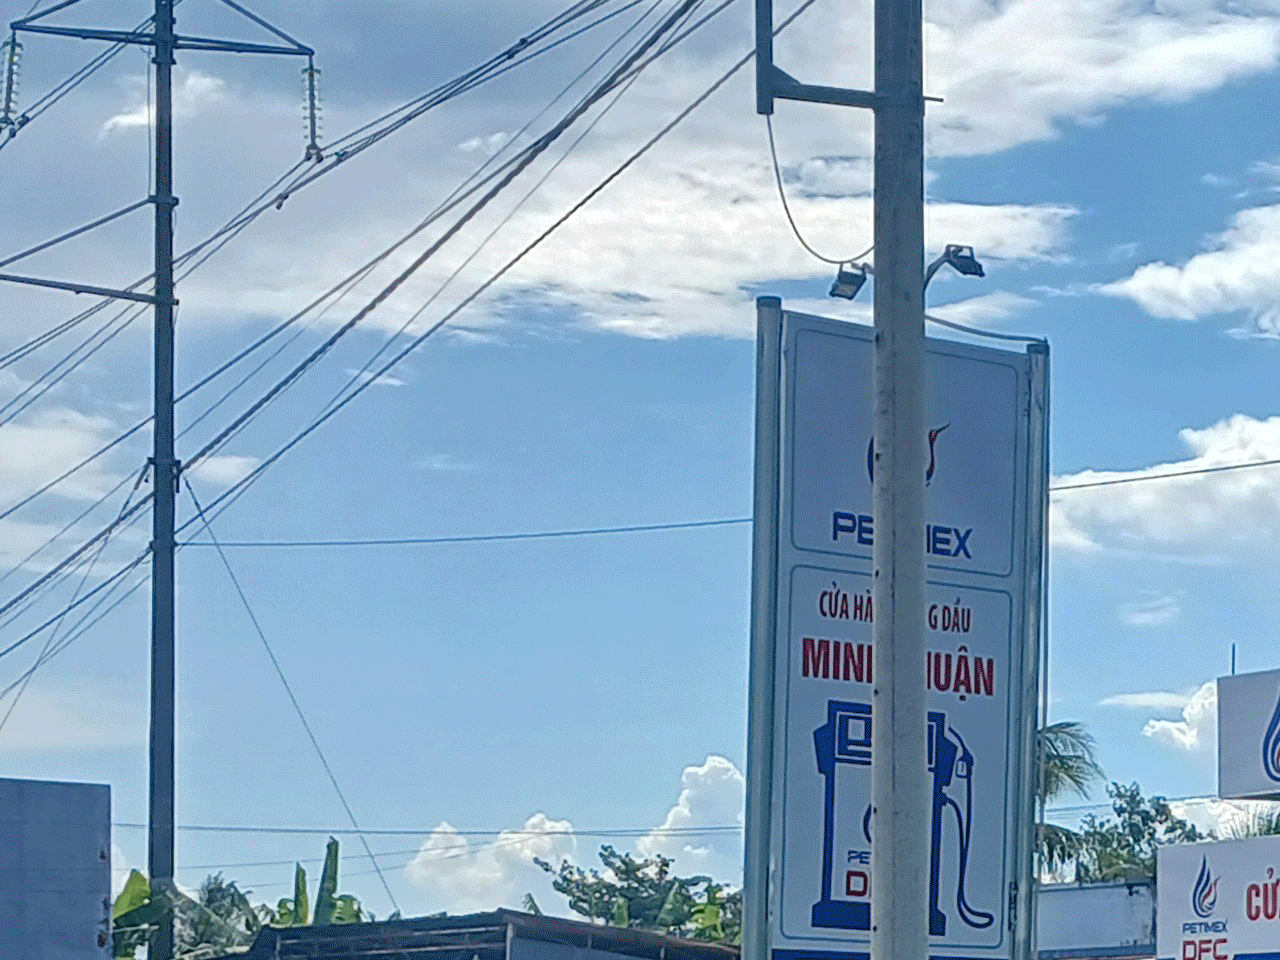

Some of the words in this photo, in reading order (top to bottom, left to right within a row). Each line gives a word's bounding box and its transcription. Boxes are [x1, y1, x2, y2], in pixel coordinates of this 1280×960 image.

[832, 511, 973, 559] PEEX
[819, 580, 849, 621] CỬA
[927, 645, 994, 702] UẬN
[1182, 920, 1228, 934] PETIMEX
